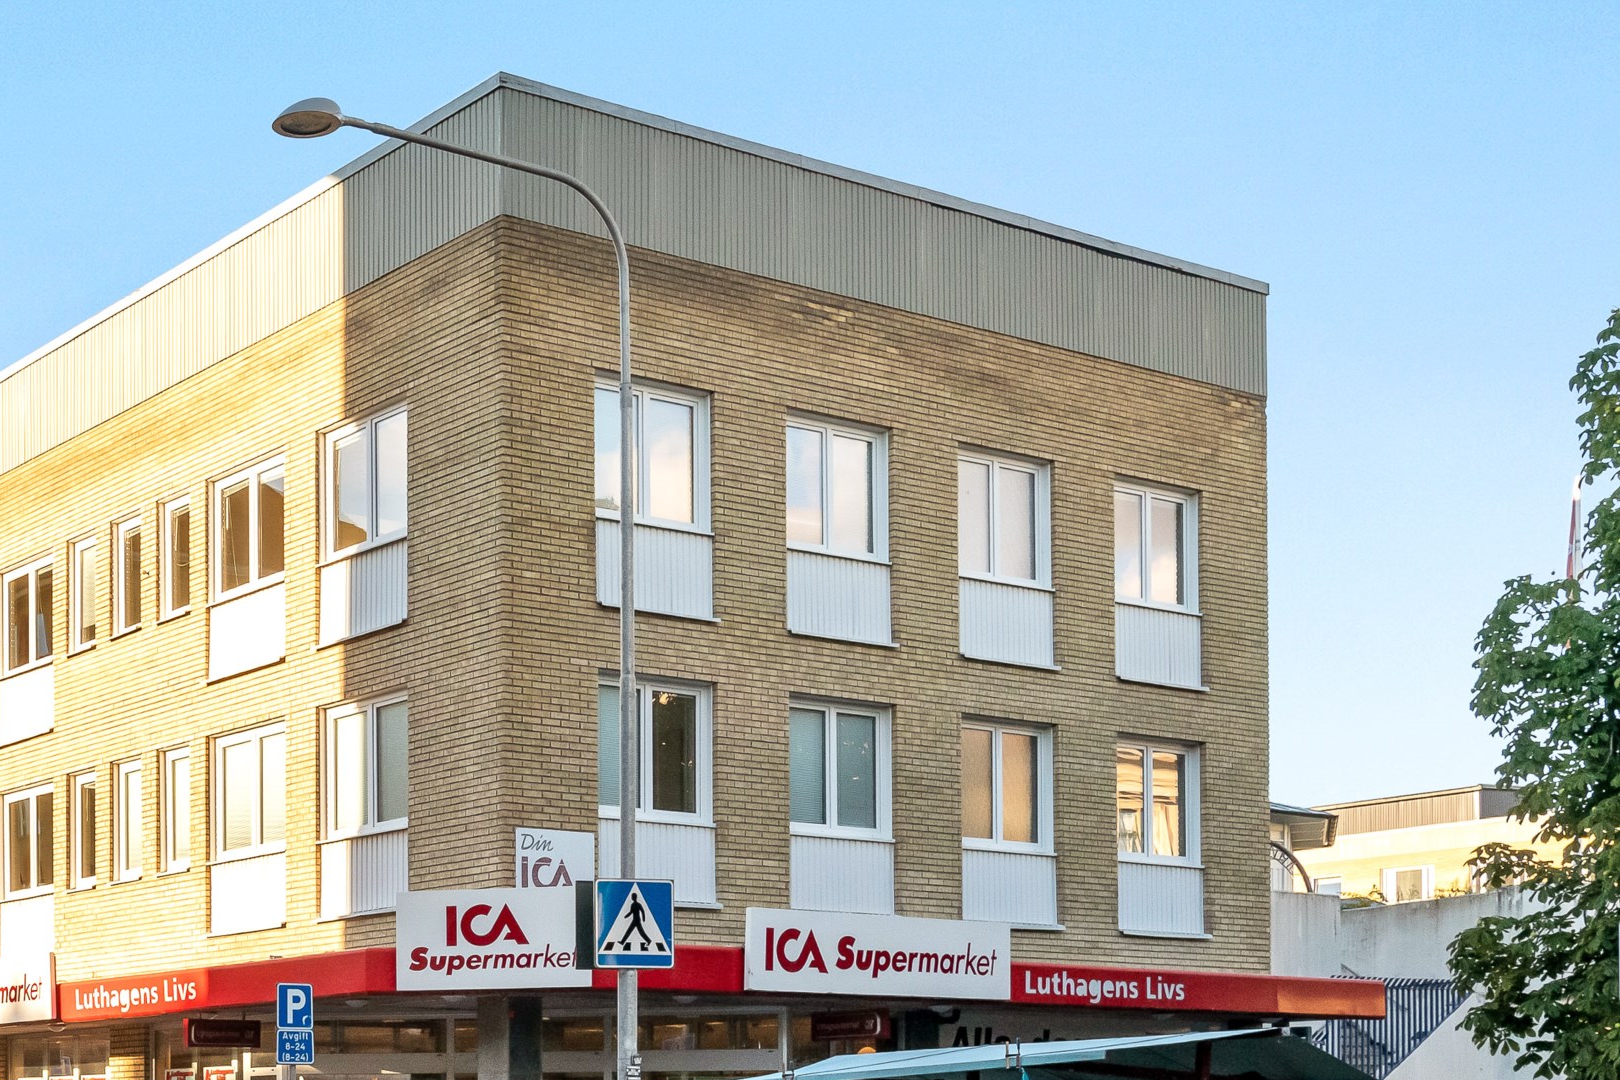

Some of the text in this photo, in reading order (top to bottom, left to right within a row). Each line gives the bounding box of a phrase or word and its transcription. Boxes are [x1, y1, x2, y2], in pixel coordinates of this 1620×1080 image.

[521, 833, 554, 851] Din
[521, 856, 573, 888] ICA
[446, 903, 530, 947] ICA
[409, 943, 577, 975] Supermarket
[765, 927, 997, 978] ICA Supermarket
[75, 977, 197, 1013] Luthagens Livs
[1025, 970, 1185, 1004] Luthagens Livs
[287, 988, 306, 1024] P
[282, 1032, 309, 1042] Avgift
[285, 1043, 306, 1051] 8-24
[282, 1053, 309, 1062] (8-24)
